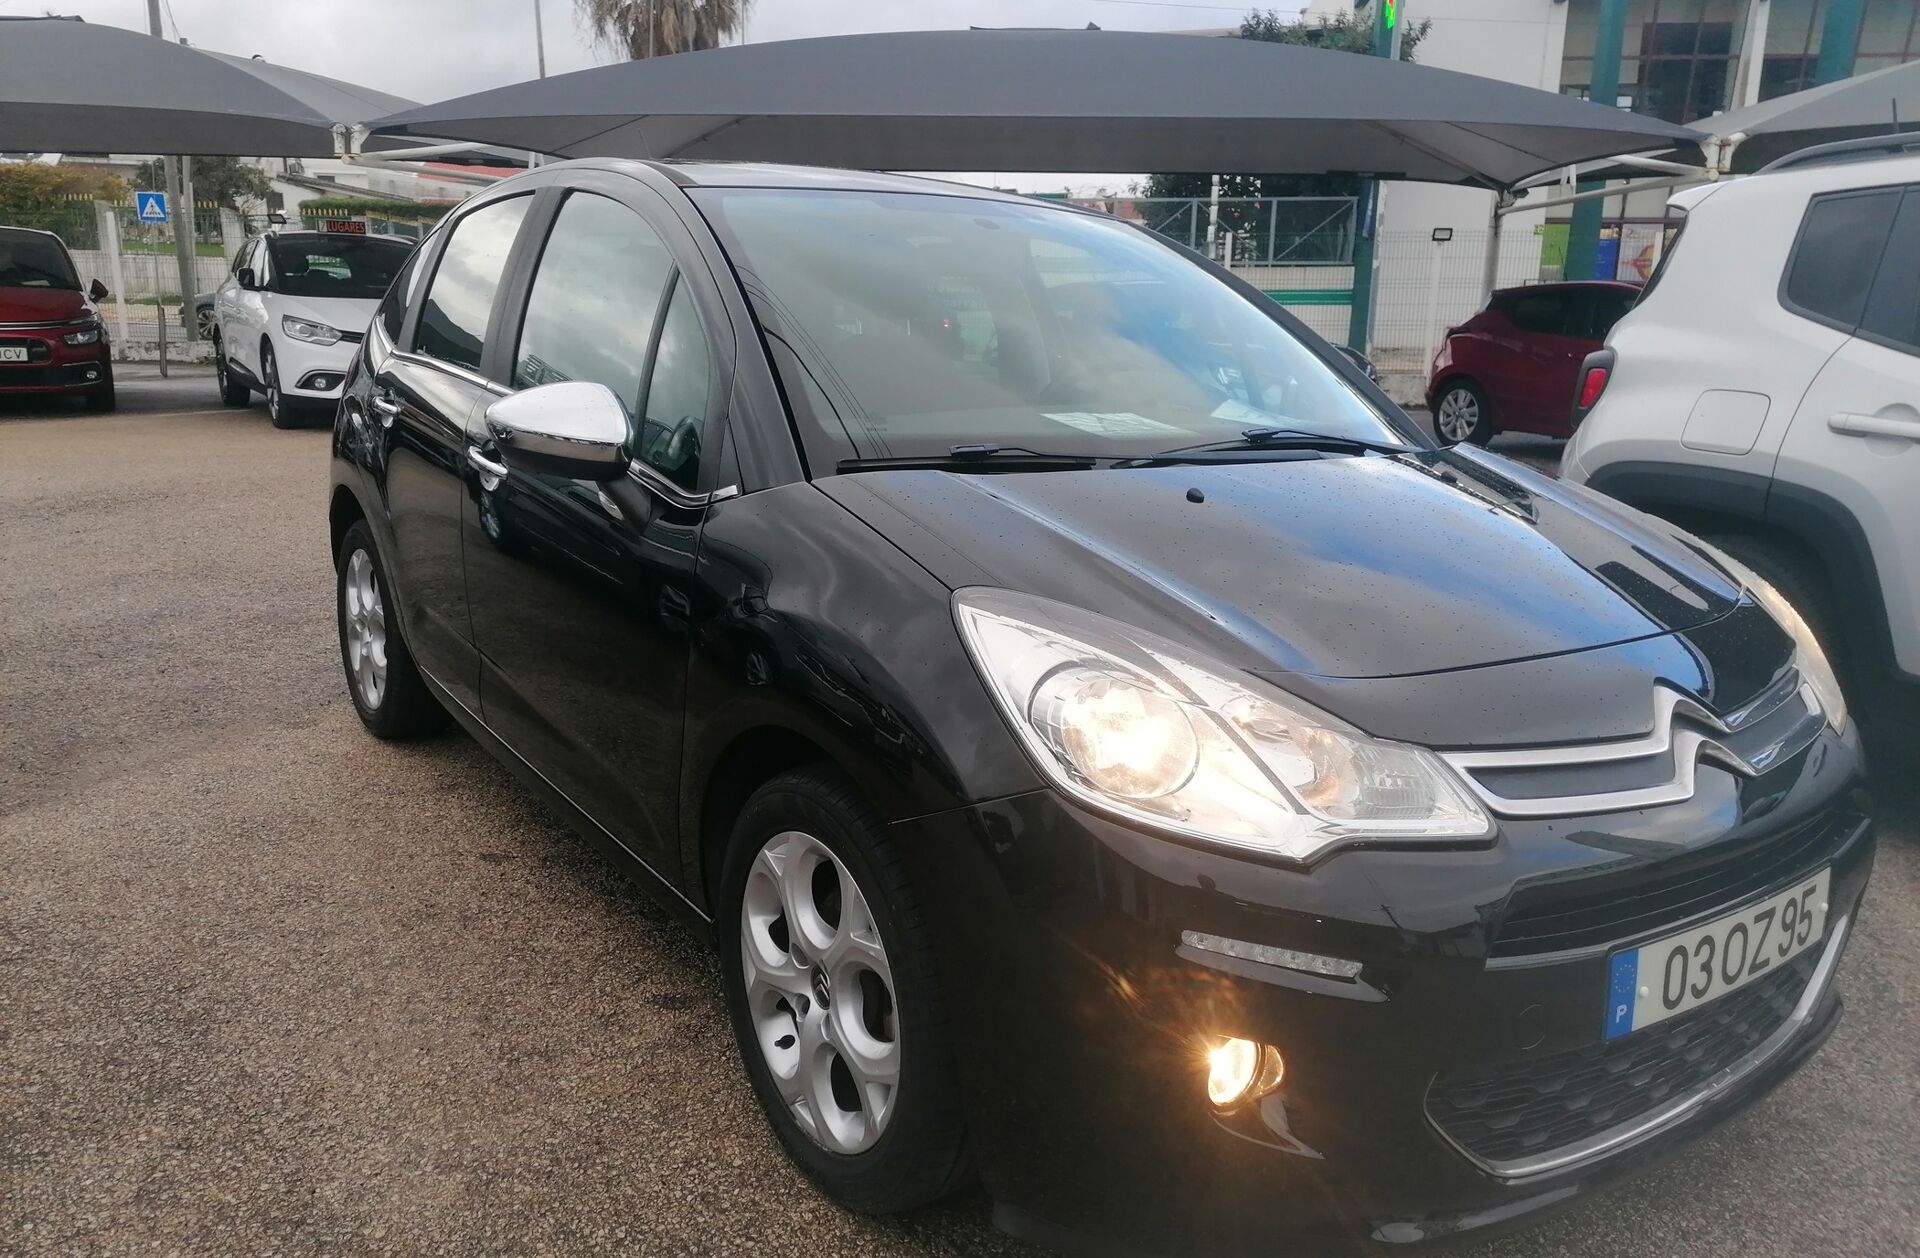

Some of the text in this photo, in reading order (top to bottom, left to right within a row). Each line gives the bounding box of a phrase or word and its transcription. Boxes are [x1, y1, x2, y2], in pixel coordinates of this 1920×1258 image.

[327, 221, 365, 233] LUGARES
[0, 348, 21, 360] CV
[1662, 884, 1817, 1011] 03OZ95
[1616, 1004, 1628, 1024] P
